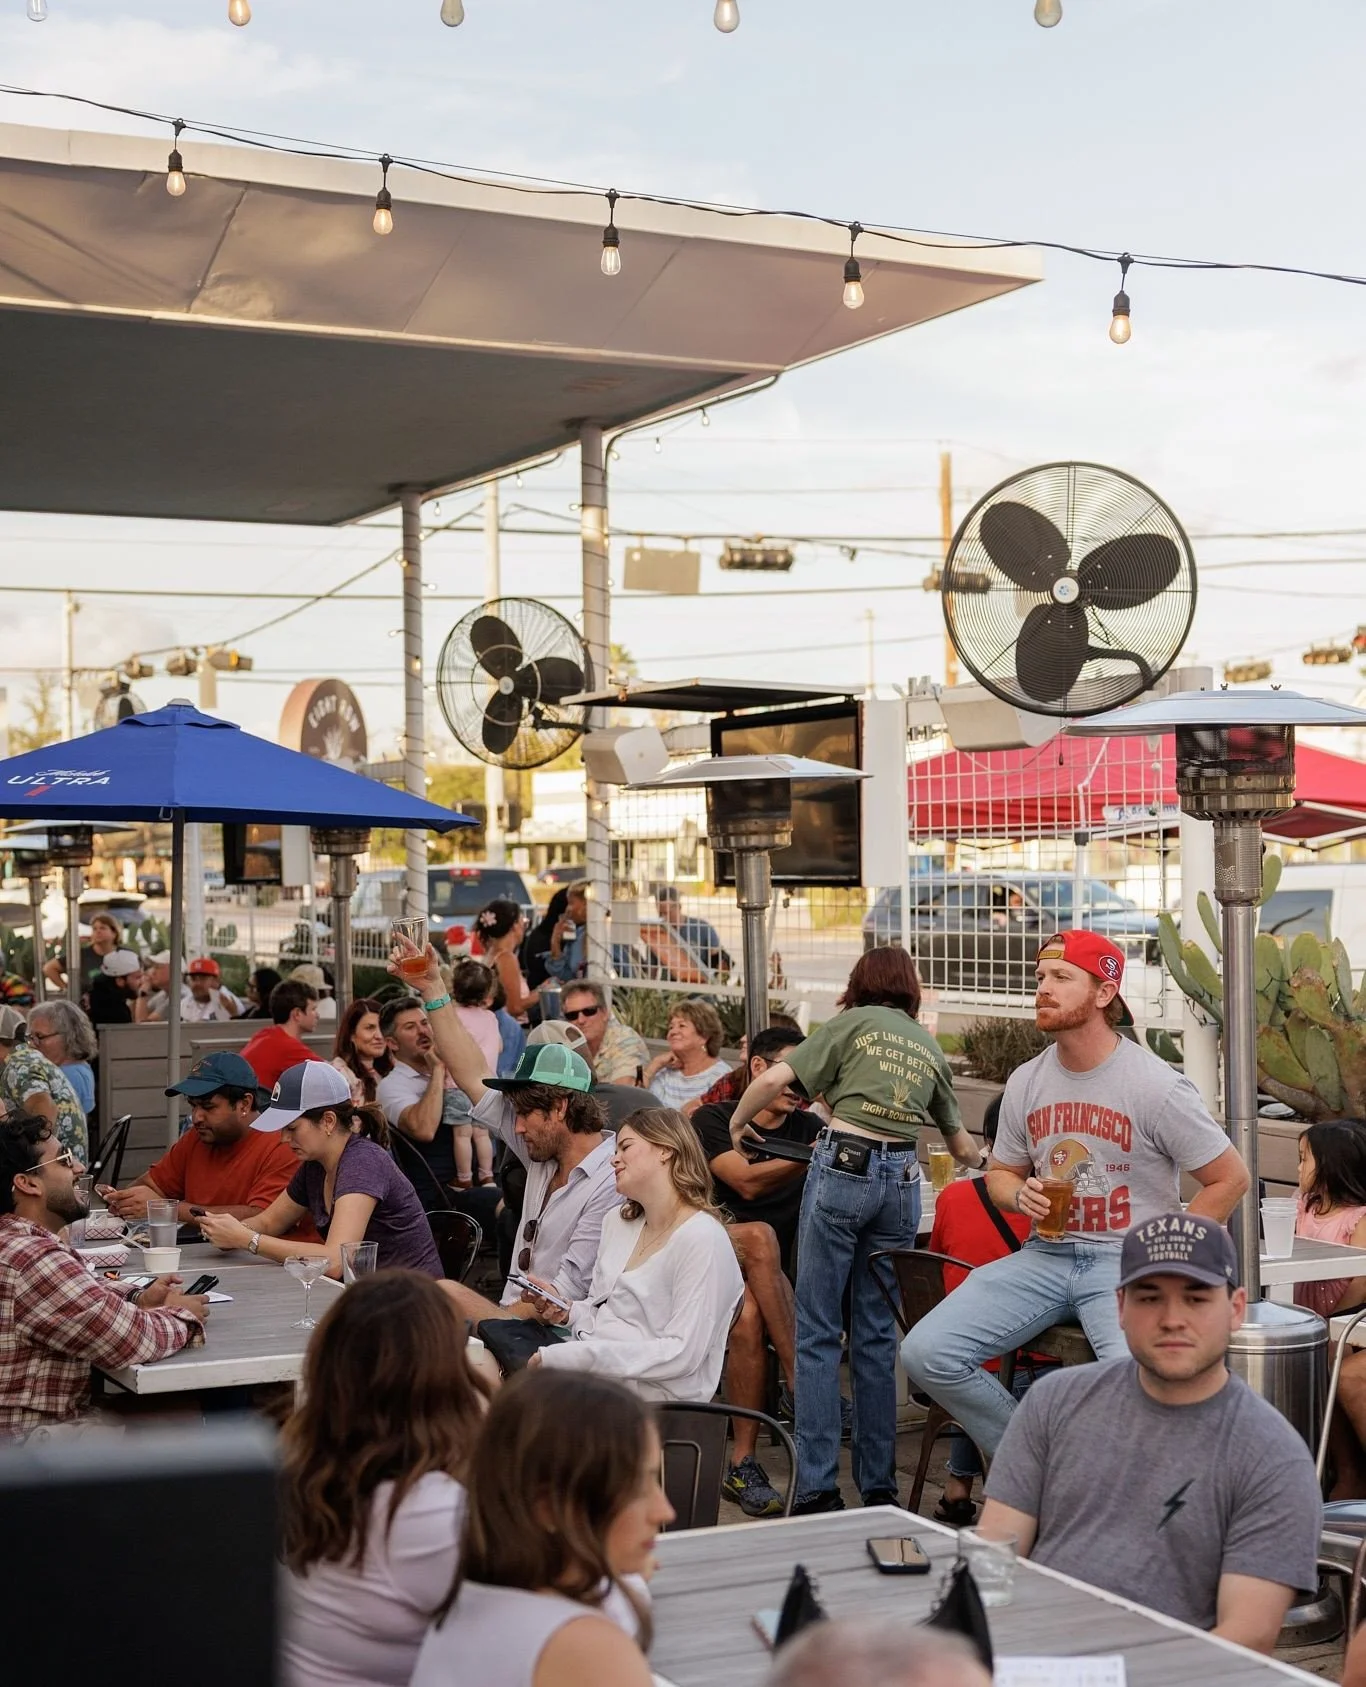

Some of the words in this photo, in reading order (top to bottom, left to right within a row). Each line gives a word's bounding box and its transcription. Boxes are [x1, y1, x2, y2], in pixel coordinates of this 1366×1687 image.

[7, 775, 111, 785] ULTRA
[854, 1031, 880, 1050] JUST
[882, 1031, 905, 1046] LIKE
[866, 1044, 883, 1056] WE
[885, 1047, 905, 1061] GET
[906, 1055, 936, 1080] BETTER
[879, 1060, 905, 1077] WITH
[905, 1070, 923, 1088] AGE
[861, 1101, 887, 1116] EIGHT
[888, 1109, 906, 1121] ROW
[1026, 1104, 1052, 1149] SAN
[1053, 1102, 1132, 1154] FRANCISCO
[1105, 1163, 1131, 1173] 1946
[1136, 1217, 1208, 1243] TEXANS
[1147, 1243, 1193, 1254] HOUSTON
[1149, 1251, 1189, 1262] FOOTBALL
